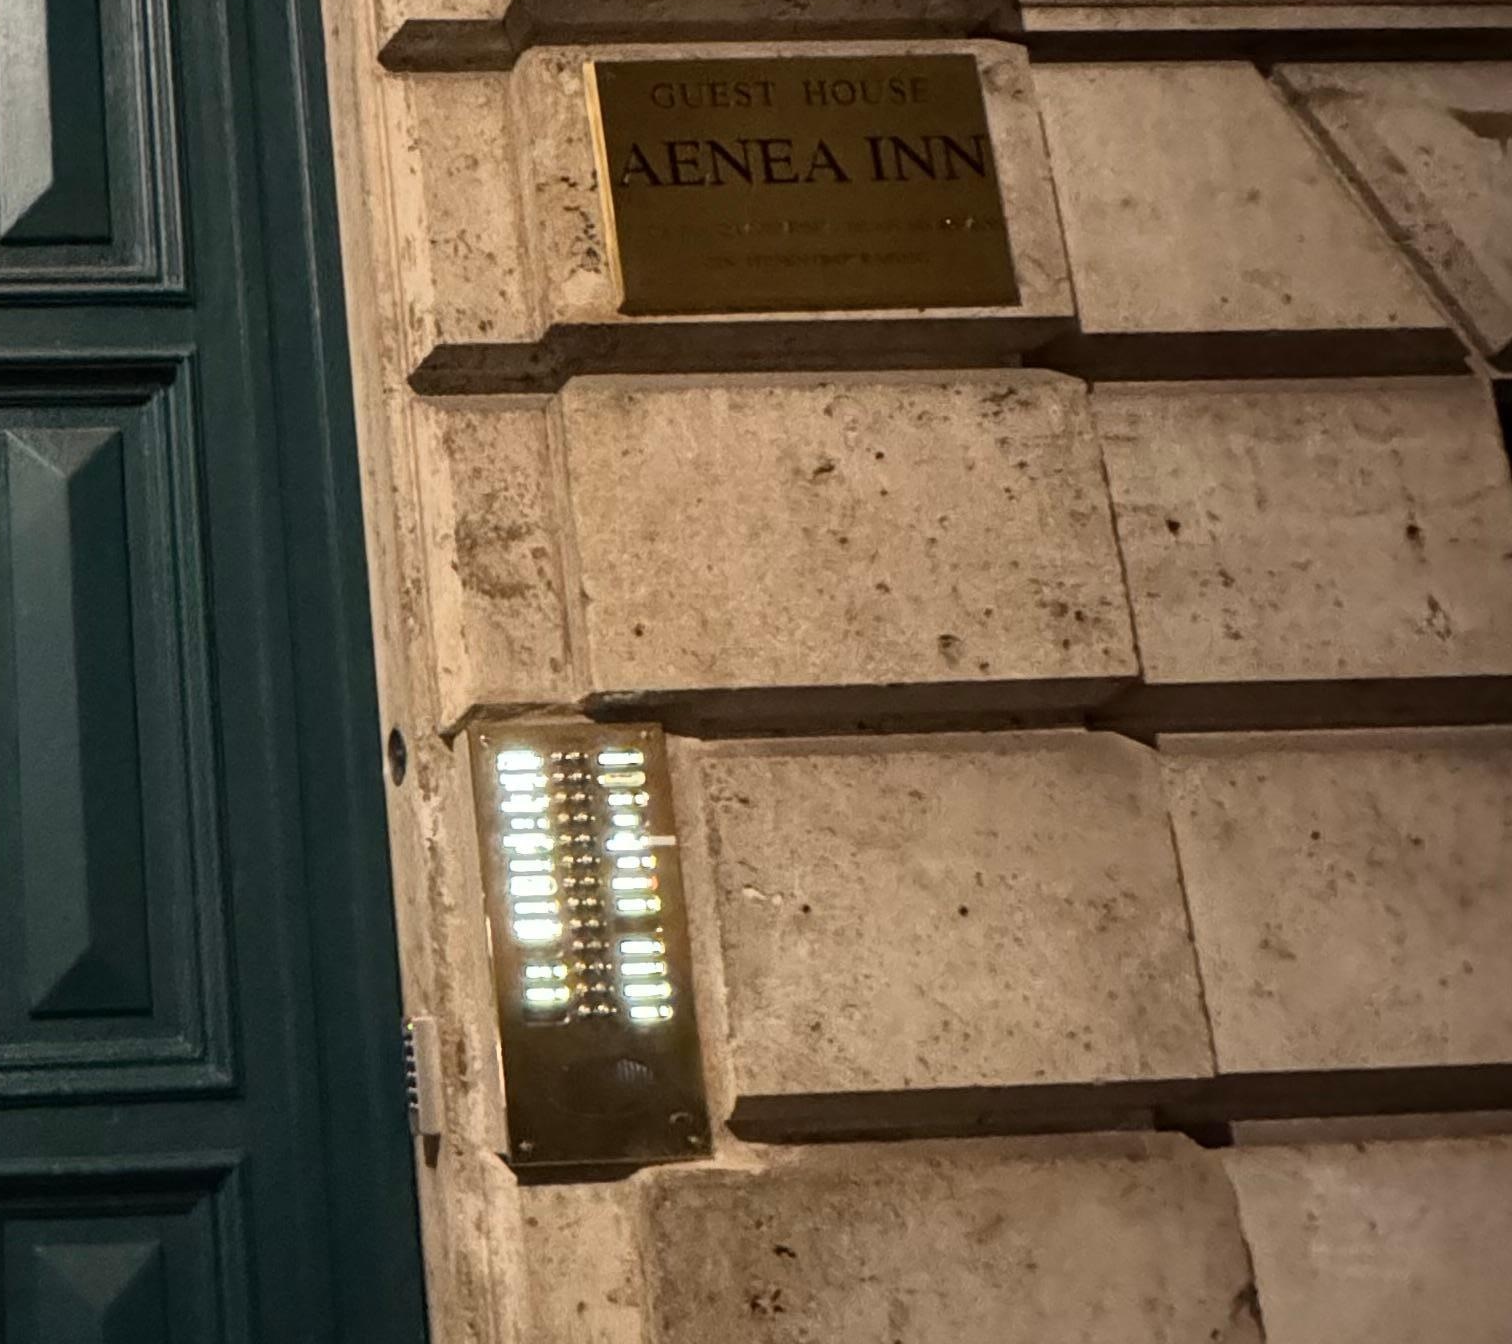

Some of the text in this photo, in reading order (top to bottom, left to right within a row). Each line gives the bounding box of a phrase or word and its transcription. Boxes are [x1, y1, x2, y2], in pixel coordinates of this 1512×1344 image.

[650, 76, 930, 109] GUEST HOUSE
[618, 133, 988, 187] AENEA INN
